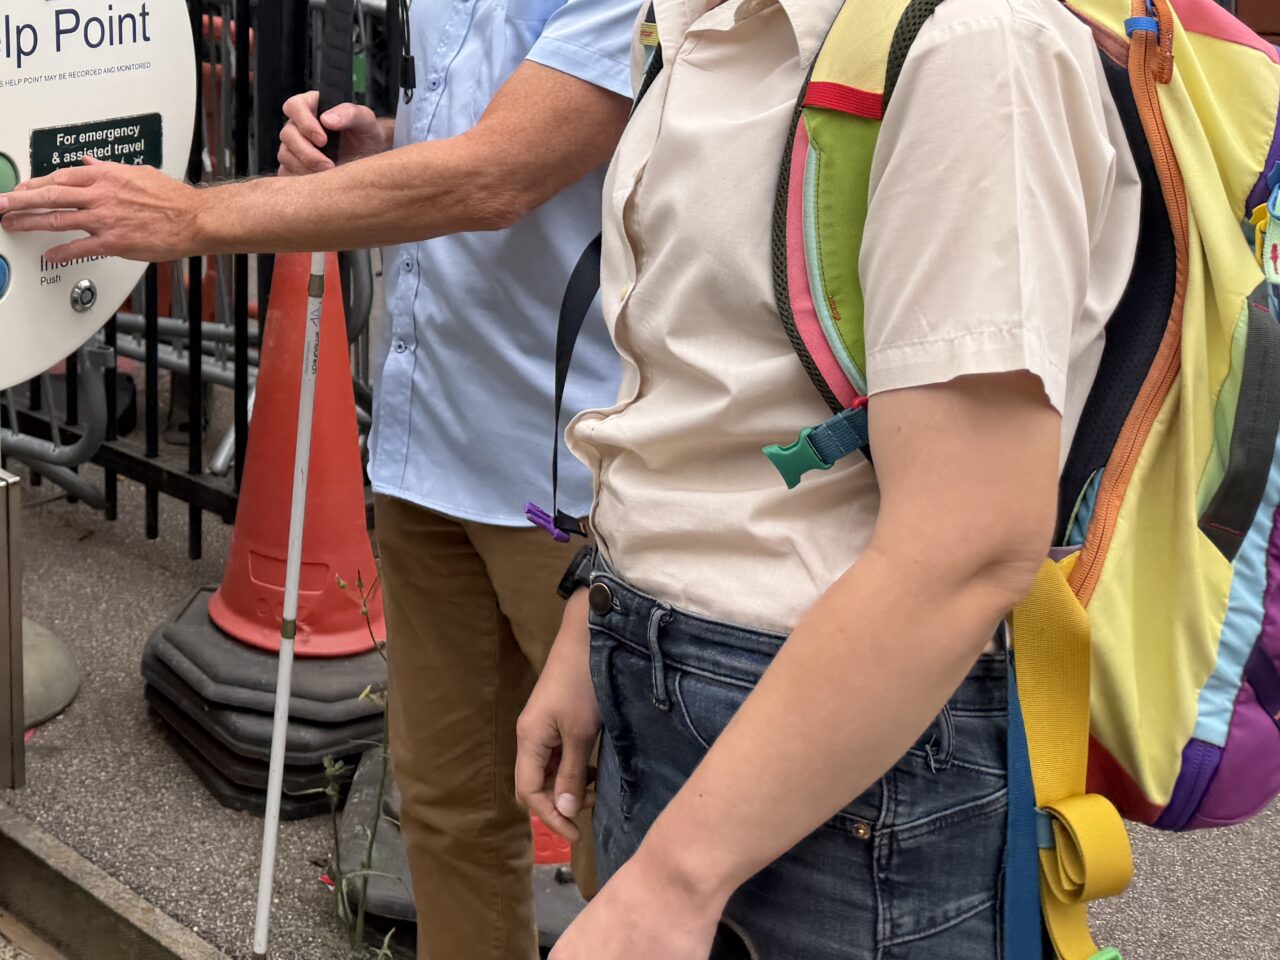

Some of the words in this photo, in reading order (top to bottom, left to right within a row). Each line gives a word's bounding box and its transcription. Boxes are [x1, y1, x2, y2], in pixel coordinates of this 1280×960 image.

[54, 2, 151, 52] Point
[5, 78, 22, 87] HELP
[24, 75, 43, 85] POINT
[44, 73, 57, 82] MAY
[58, 72, 67, 80] BE
[68, 68, 102, 79] RECORDED
[116, 62, 151, 73] MONITORED
[56, 133, 76, 146] For
[79, 124, 140, 142] emergency
[51, 151, 60, 164] &
[63, 144, 111, 162] assisted
[114, 139, 145, 156] travel
[40, 274, 61, 286] Push
